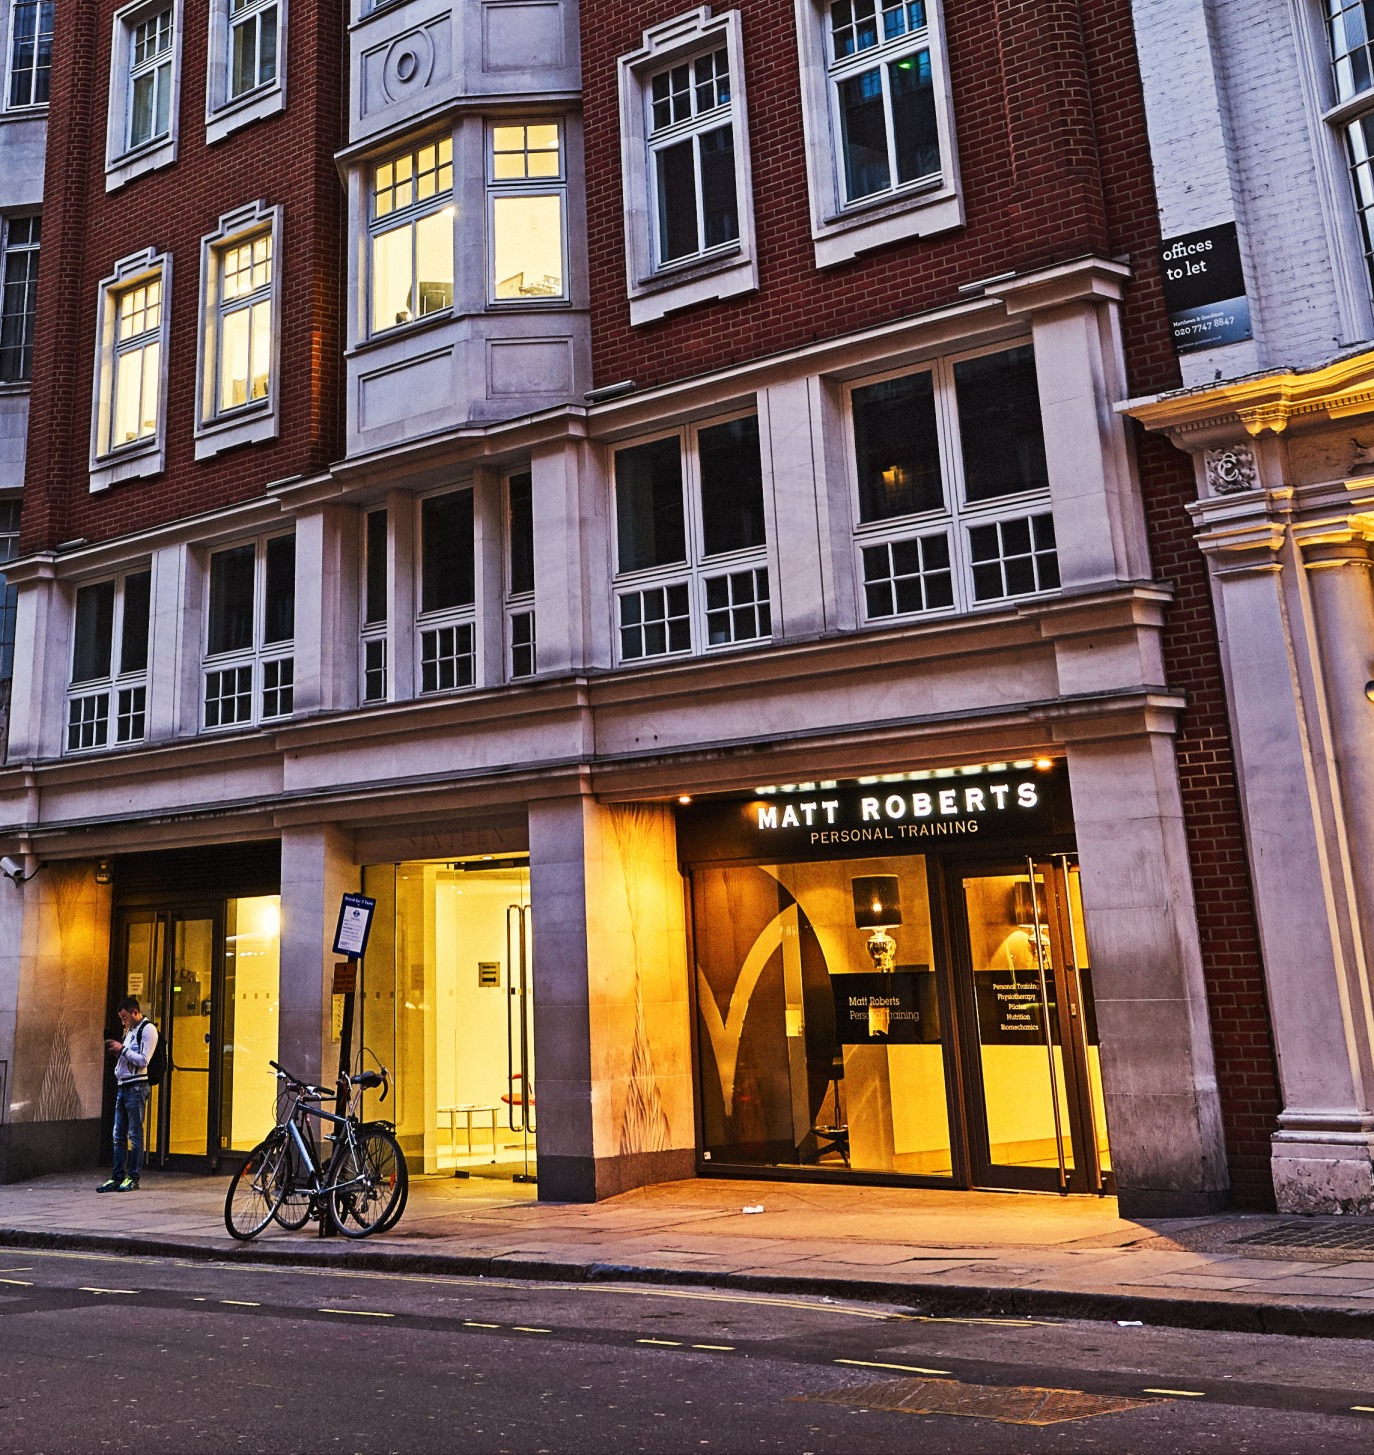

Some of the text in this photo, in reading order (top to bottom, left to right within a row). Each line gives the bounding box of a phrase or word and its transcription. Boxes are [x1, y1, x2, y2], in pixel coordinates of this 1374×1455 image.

[1162, 240, 1213, 261] offices
[1167, 260, 1207, 281] to let
[1174, 316, 1235, 337] 020 7747 8847
[757, 782, 1038, 830] MATT ROBERTS
[810, 819, 978, 845] PERSONAL TRAINING
[849, 996, 900, 1006] Matt Roberts
